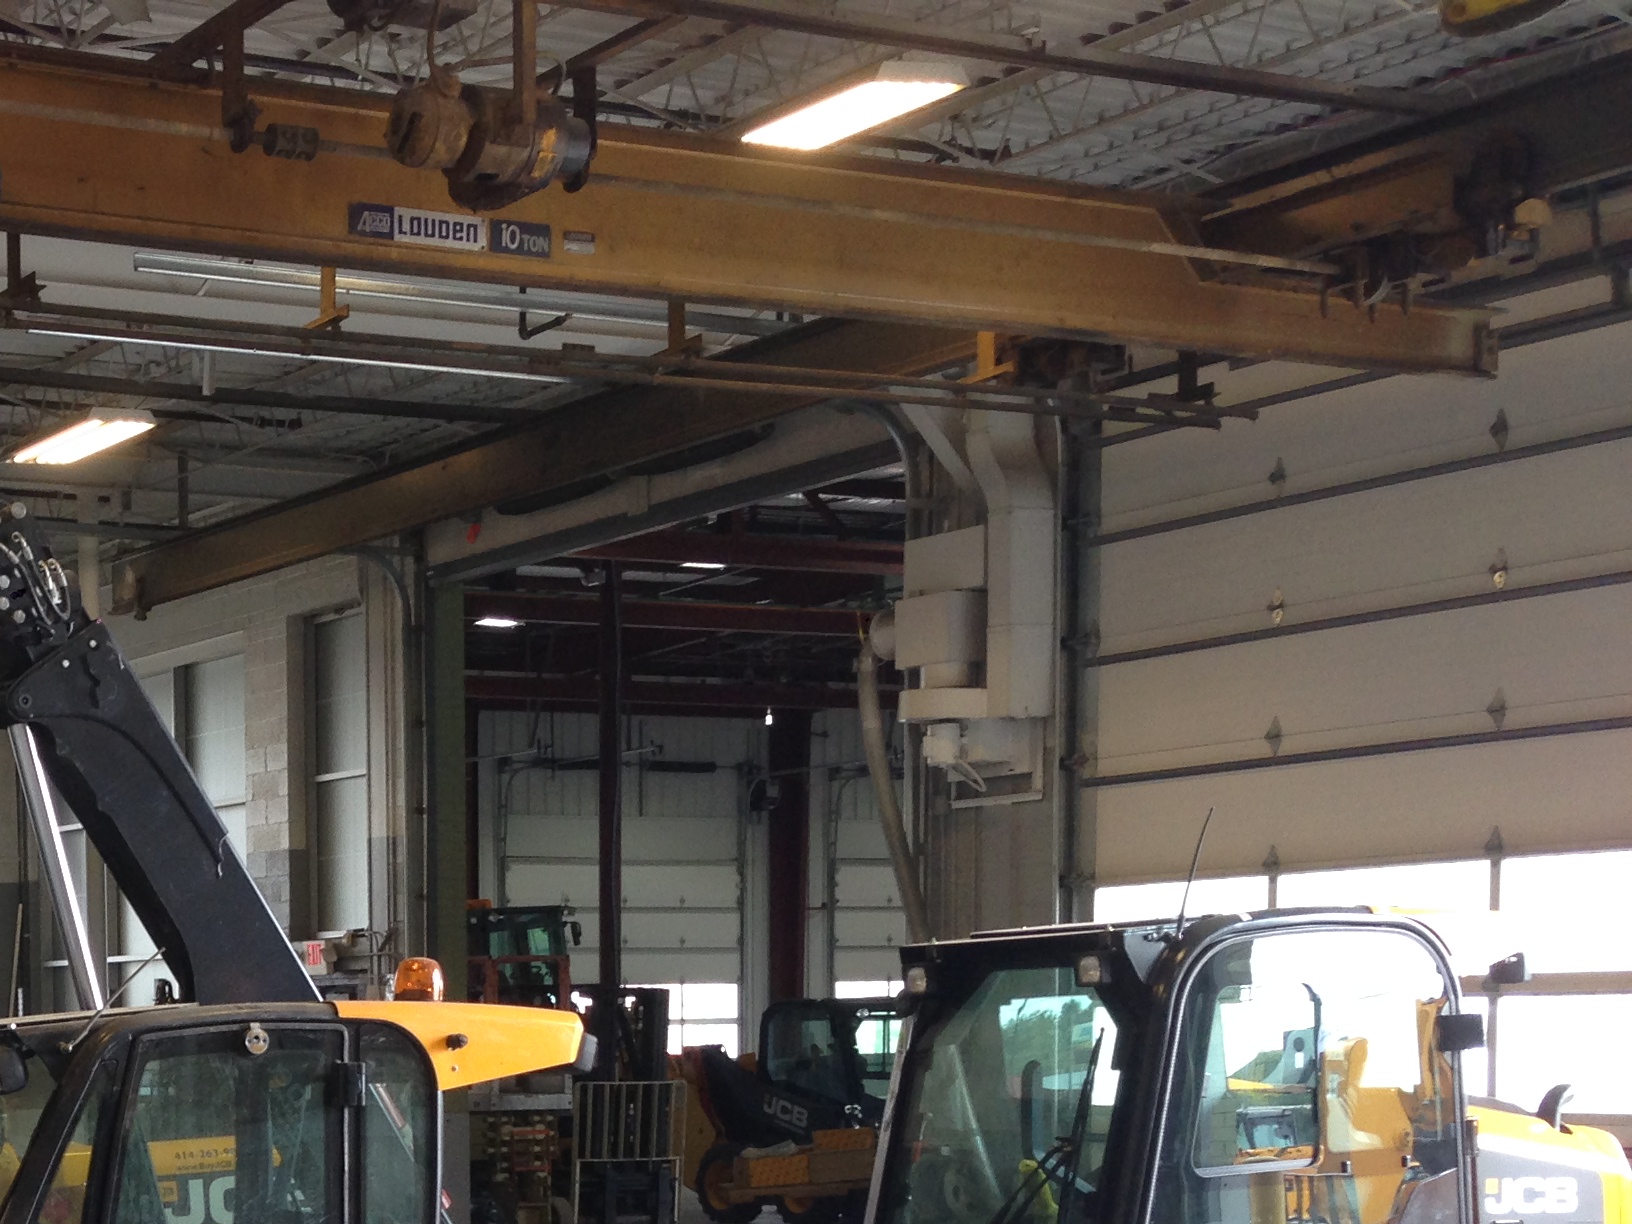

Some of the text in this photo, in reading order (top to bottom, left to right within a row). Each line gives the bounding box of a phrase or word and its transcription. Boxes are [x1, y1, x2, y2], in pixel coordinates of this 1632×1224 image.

[501, 222, 549, 254] 10 TON
[763, 1096, 809, 1128] JCB
[1484, 1176, 1579, 1214] JCB
